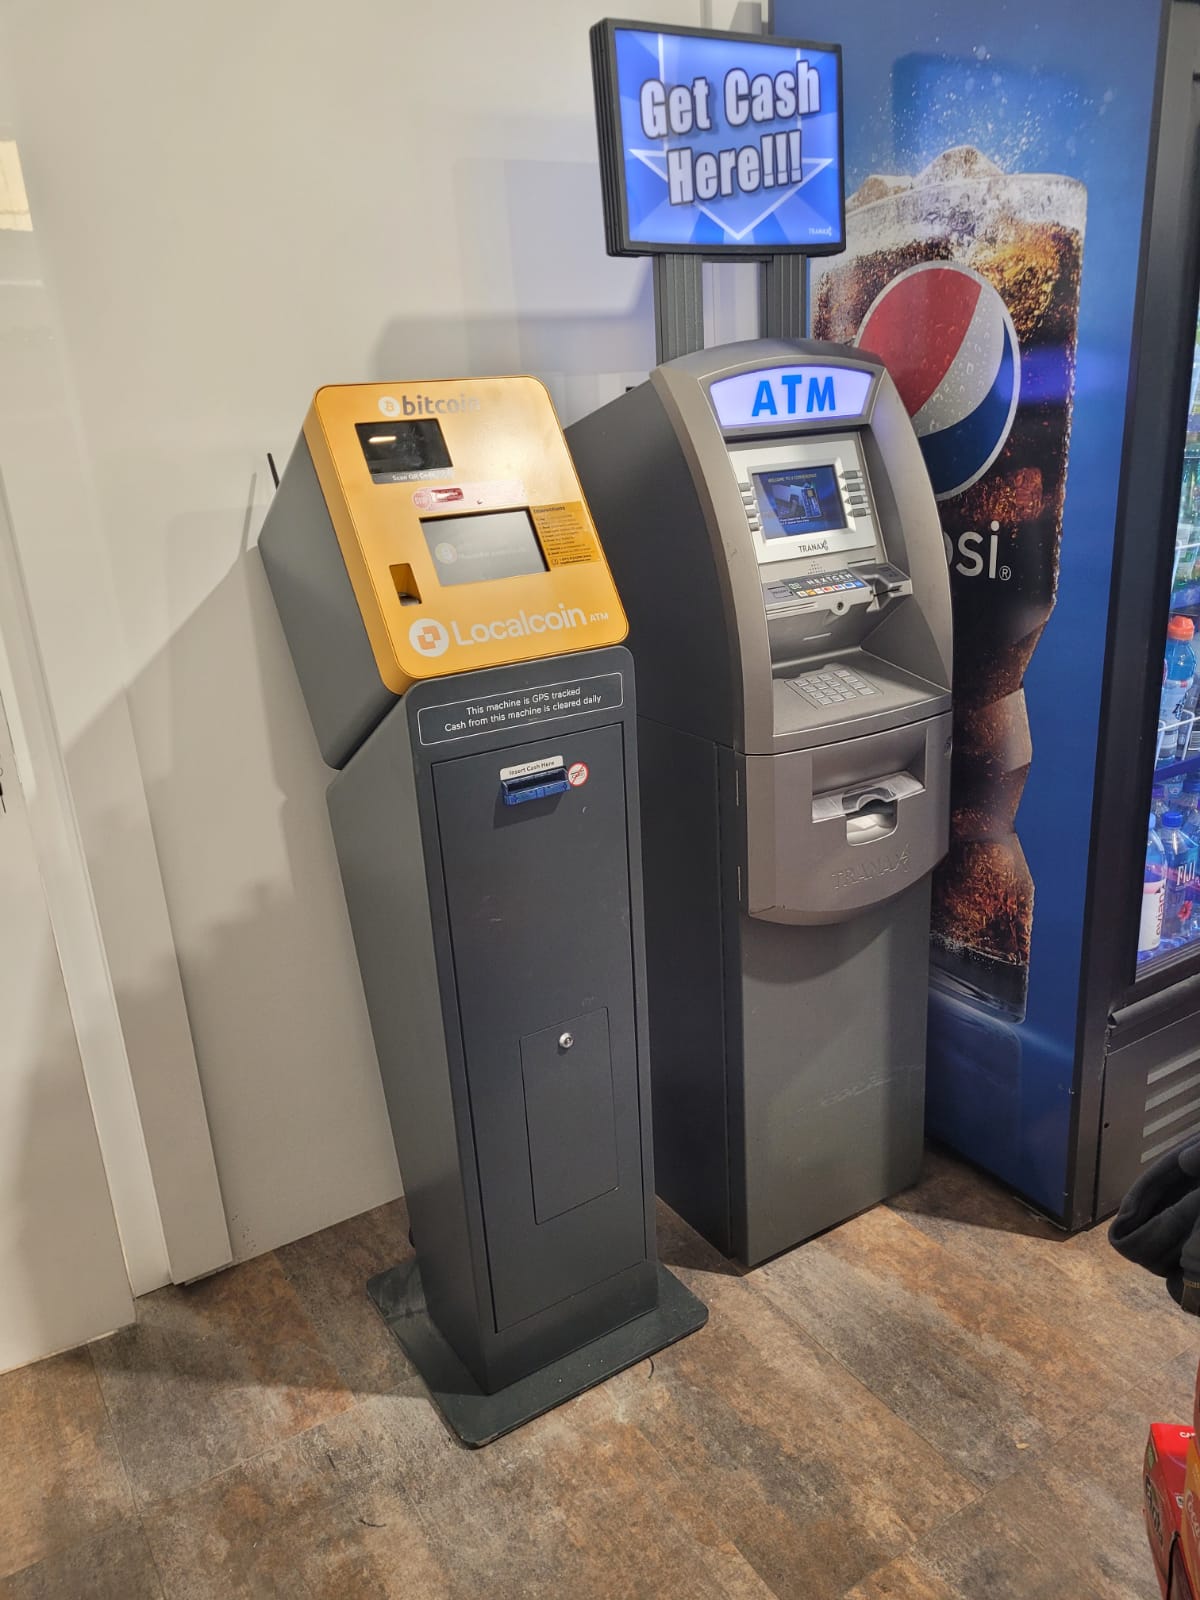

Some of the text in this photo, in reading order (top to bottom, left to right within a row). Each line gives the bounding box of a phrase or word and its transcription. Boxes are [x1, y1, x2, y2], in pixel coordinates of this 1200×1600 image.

[641, 60, 821, 140] Get Cash
[666, 129, 802, 206] Here!!!
[402, 393, 481, 416] bitcoin
[751, 374, 836, 417] ATM
[798, 540, 828, 552] TRANAX
[943, 520, 1000, 579] si
[451, 603, 609, 646] Localcoin ATM
[445, 694, 602, 732] Cash from this machine is cleared daily
[466, 687, 581, 716] This machine is GPS tracked
[509, 766, 526, 775] Insert
[526, 763, 541, 772] Cash
[1177, 861, 1196, 886] FIJI
